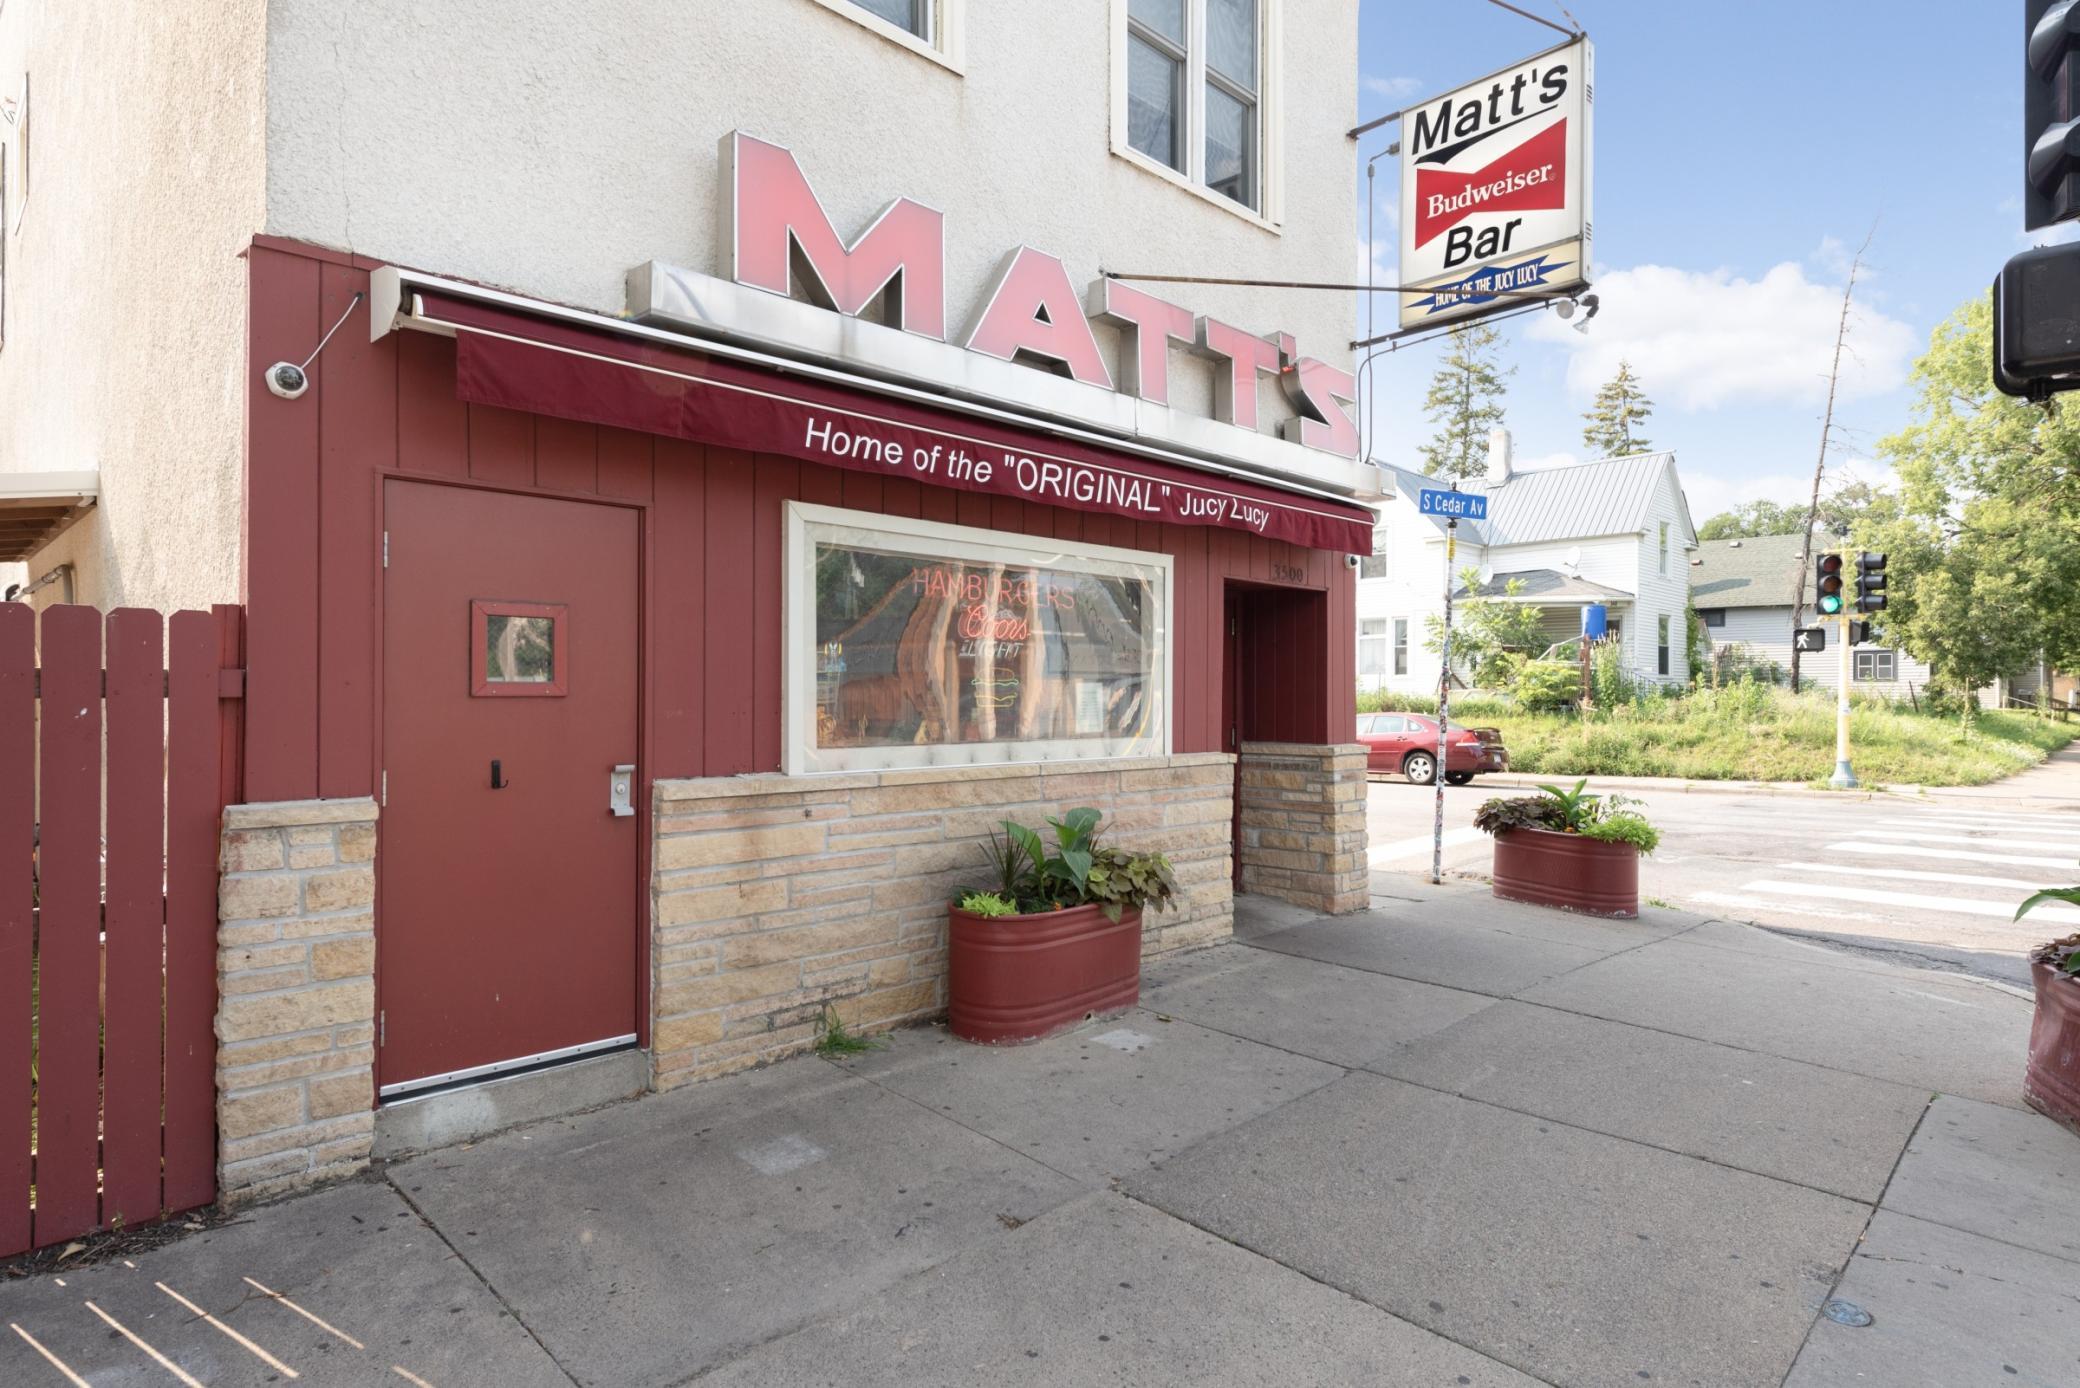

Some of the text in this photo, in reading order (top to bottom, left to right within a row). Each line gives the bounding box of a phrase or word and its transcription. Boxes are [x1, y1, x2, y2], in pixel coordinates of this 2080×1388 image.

[1411, 64, 1569, 155] Matt's
[1426, 164, 1553, 219] Budweiser
[1443, 217, 1523, 269] Bar
[718, 129, 1360, 460] MATT'S
[1435, 263, 1539, 308] HOME OF THE JUCY LUCY
[805, 417, 1270, 532] Home of the "ORIGINAL" Jucy Lucy
[1423, 493, 1484, 516] S Cedar Av
[911, 567, 1076, 610] HAMBURGERS
[965, 604, 1029, 641] Coors
